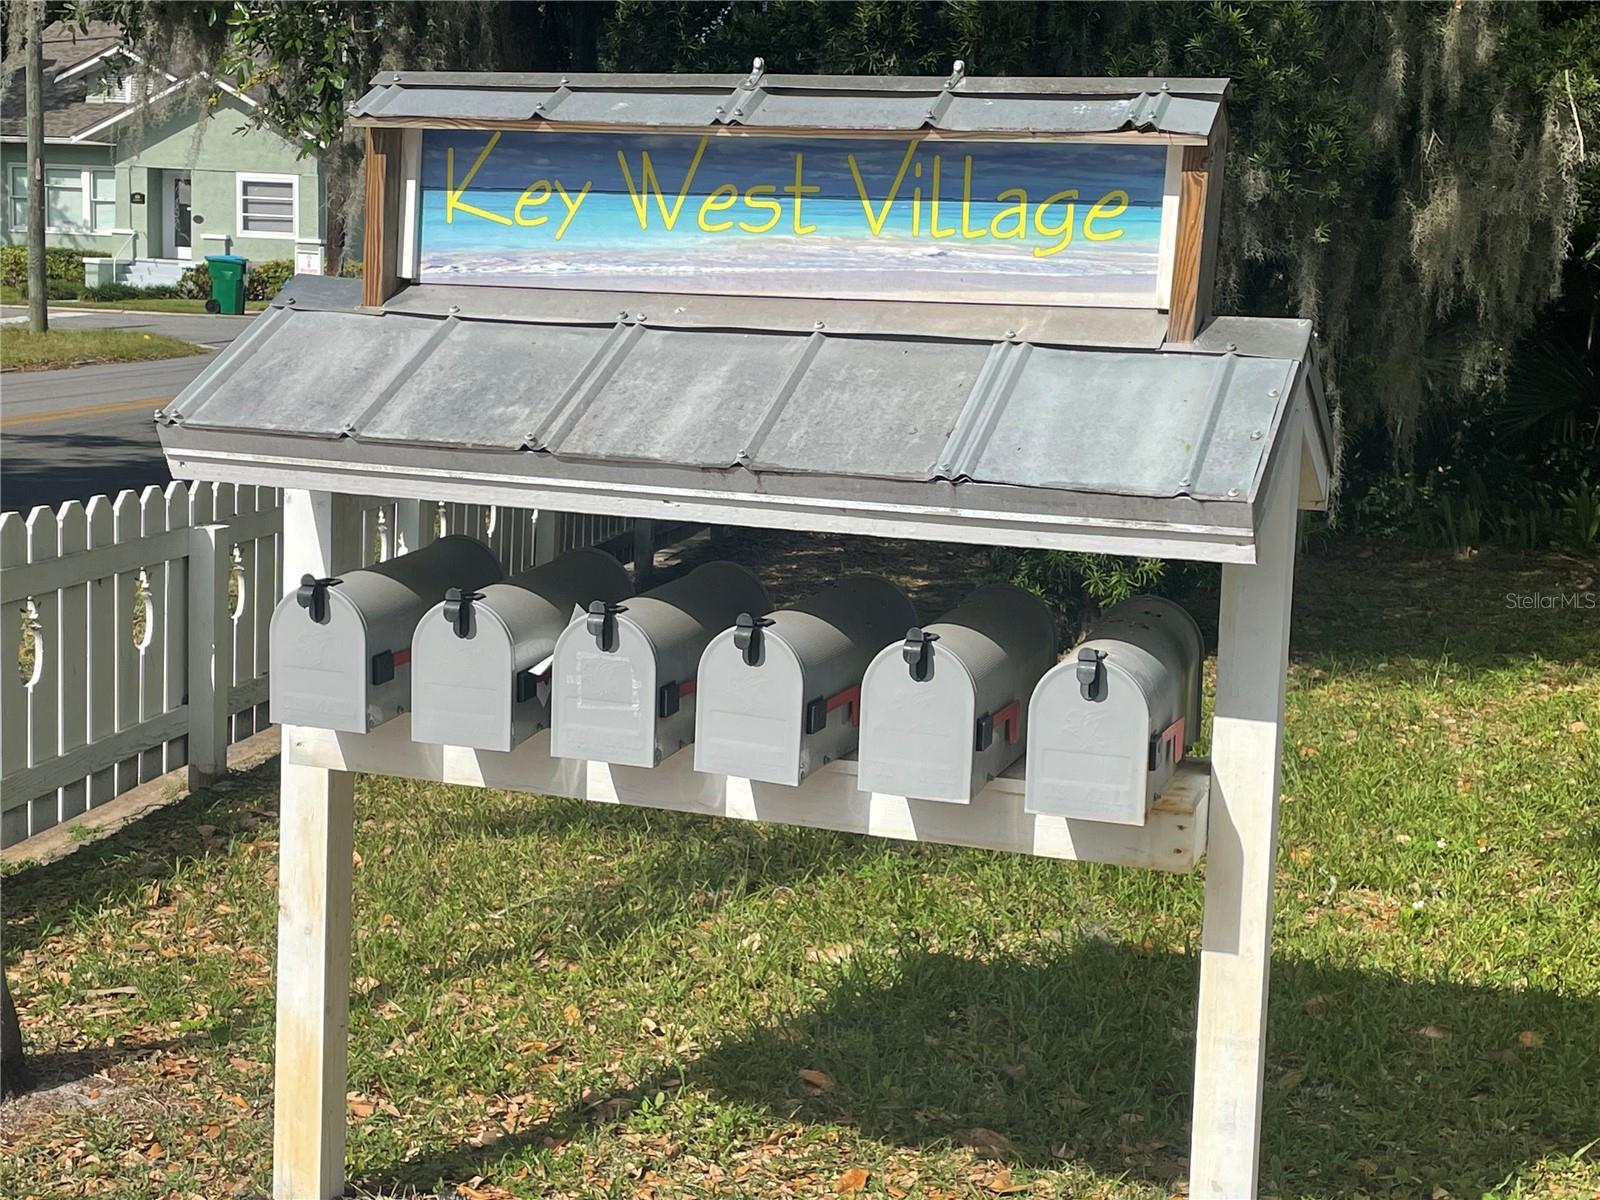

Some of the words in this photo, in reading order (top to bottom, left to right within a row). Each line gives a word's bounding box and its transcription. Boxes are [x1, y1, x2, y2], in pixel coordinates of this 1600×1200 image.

[446, 131, 592, 240] Key
[617, 136, 820, 235] West
[847, 139, 1130, 257] Village
